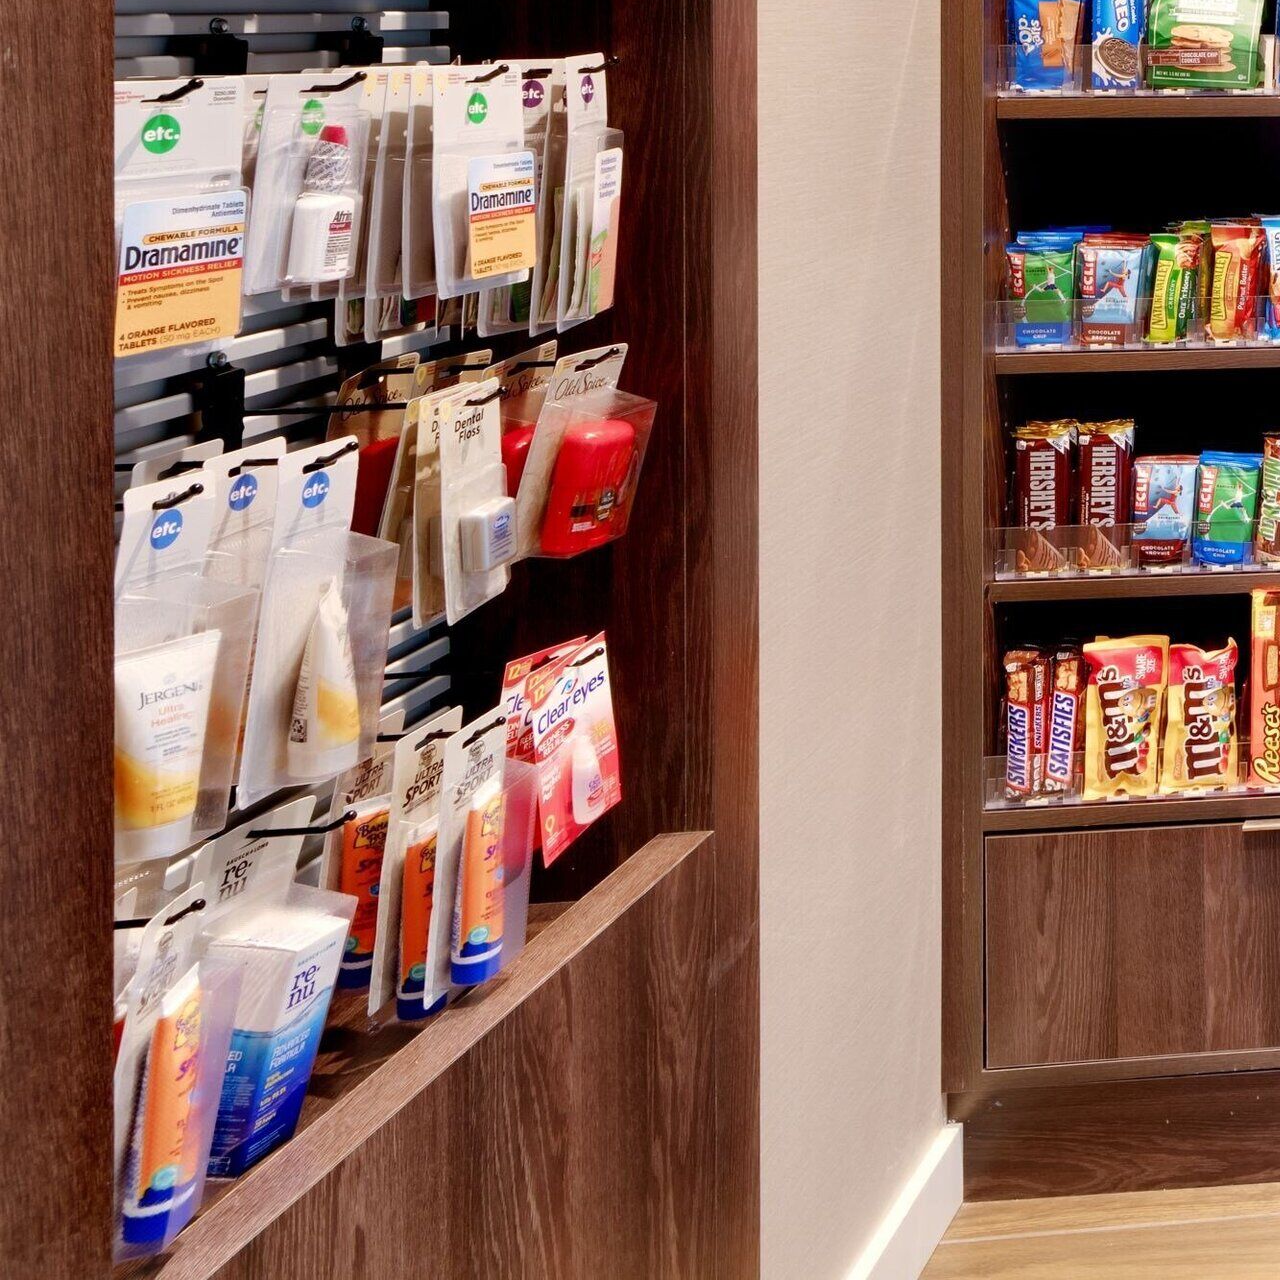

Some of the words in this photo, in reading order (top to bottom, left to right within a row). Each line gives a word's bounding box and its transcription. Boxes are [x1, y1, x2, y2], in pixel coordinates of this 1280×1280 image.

[468, 102, 487, 114] etc.
[144, 124, 180, 142] etc.
[222, 200, 244, 210] Tablets
[471, 188, 534, 212] Dramamine
[148, 231, 196, 243] CHEWABLE
[198, 225, 239, 238] FORMULA
[125, 238, 240, 271] Dramamine
[123, 272, 161, 283] MOTION
[162, 266, 204, 279] SICKNESS
[206, 259, 239, 272] RELIEF
[127, 324, 166, 338] ORANGE
[168, 317, 216, 332] FLAVORED
[118, 338, 158, 351] TABLETS
[454, 408, 485, 432] Dental
[458, 426, 481, 445] Floss
[230, 483, 257, 502] etc.
[302, 483, 329, 500] etc.
[1029, 451, 1056, 532] HERSHEY'S
[1090, 446, 1117, 528] HERSHEY'S
[153, 522, 181, 539] etc.
[1203, 547, 1236, 555] CHOCOLATE
[537, 694, 571, 735] Clear
[573, 669, 605, 705] eyes
[1048, 693, 1074, 776] SATISFIES
[1007, 704, 1026, 787] SNICKERS
